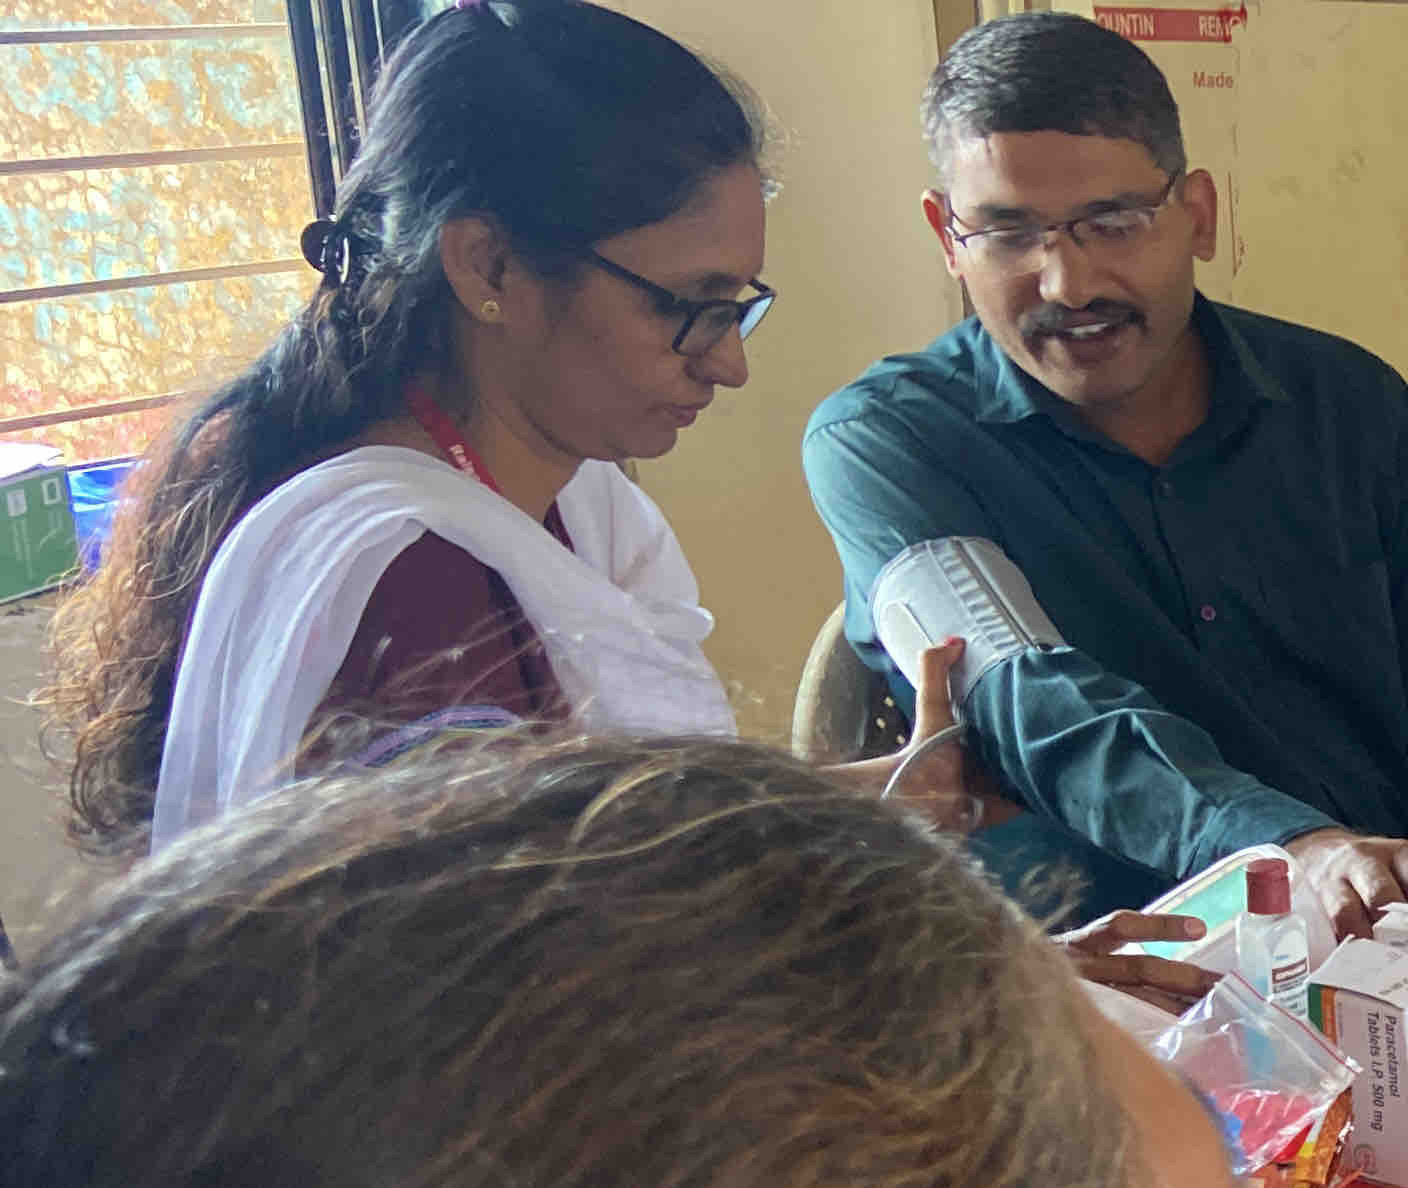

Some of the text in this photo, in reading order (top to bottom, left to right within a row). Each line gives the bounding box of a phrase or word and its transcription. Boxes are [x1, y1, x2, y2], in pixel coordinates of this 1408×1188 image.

[1193, 72, 1233, 88] Made
[1367, 1011, 1382, 1056] Tablets
[1384, 1014, 1401, 1099] Paracetamol
[1372, 1083, 1386, 1107] 500
[1370, 1109, 1385, 1132] mg
